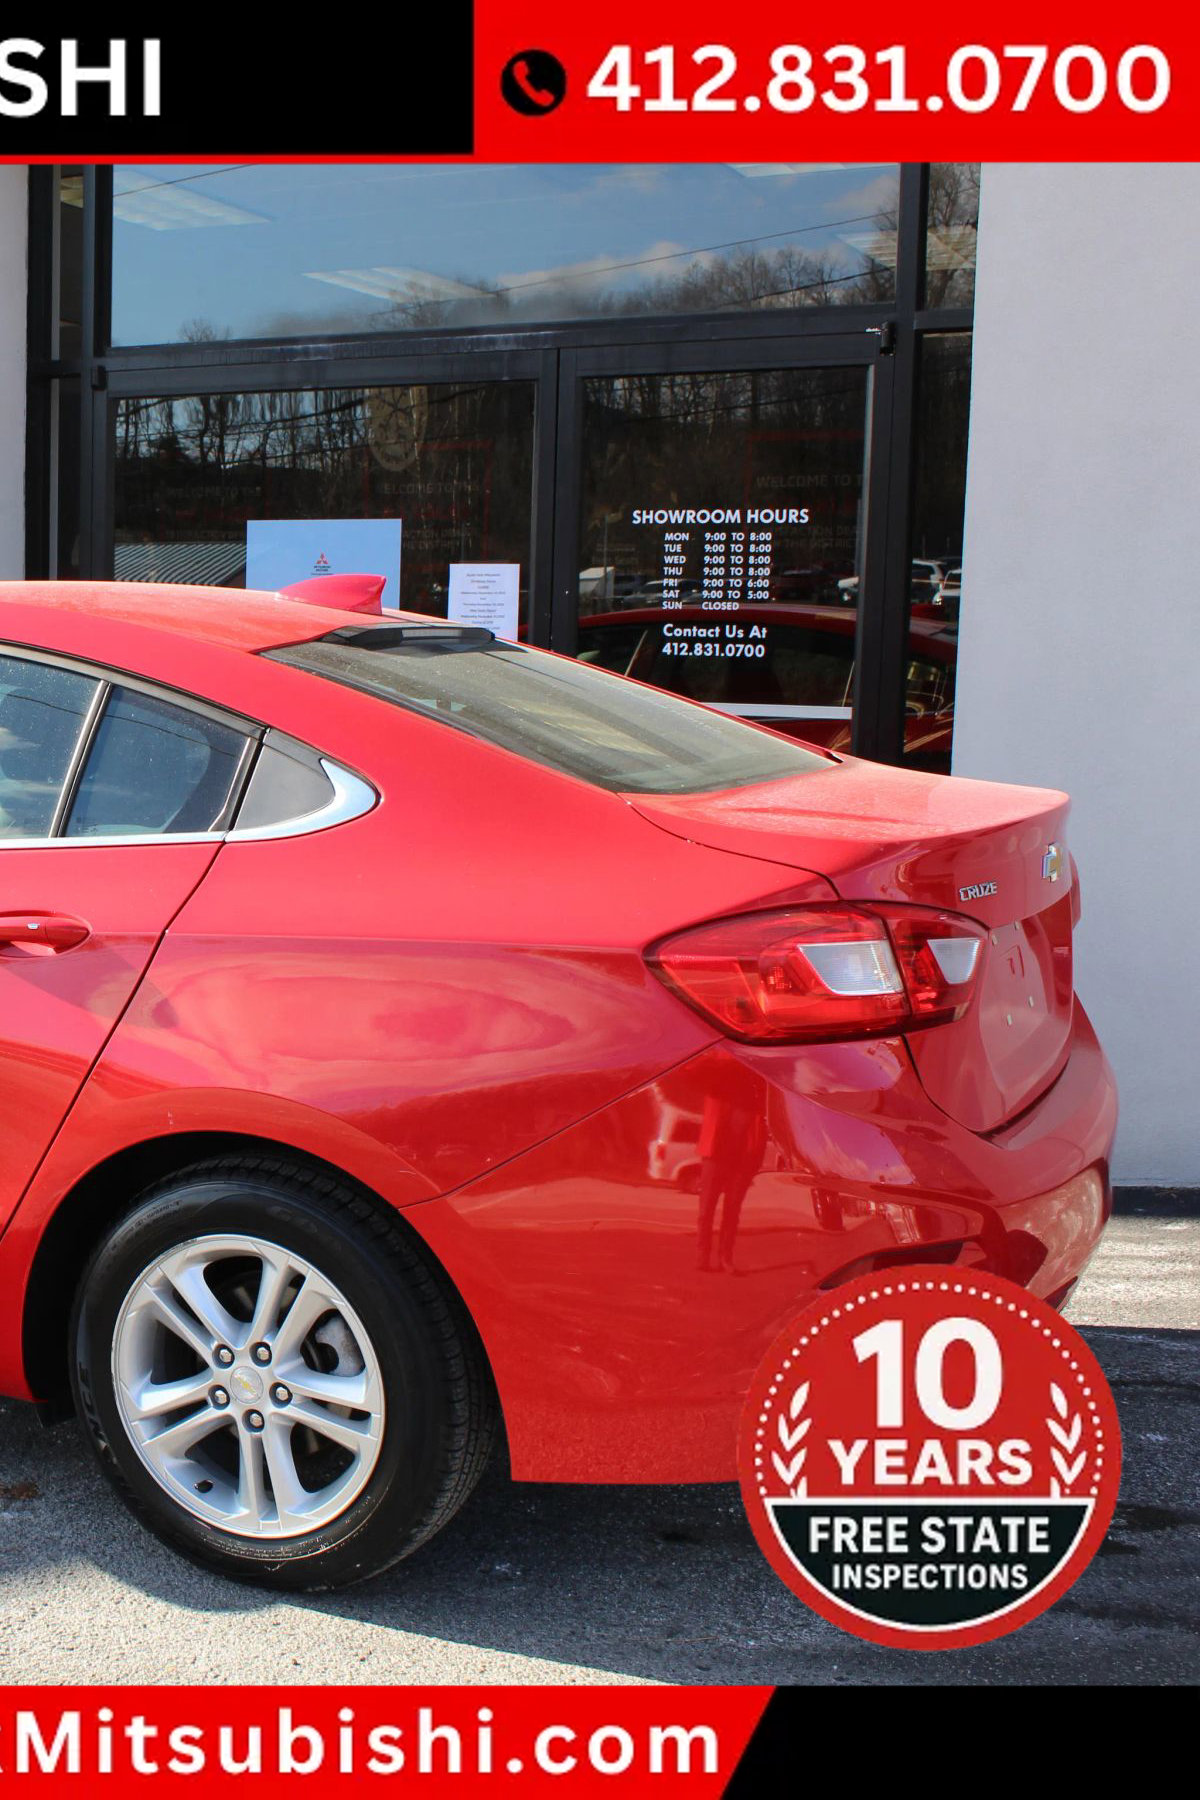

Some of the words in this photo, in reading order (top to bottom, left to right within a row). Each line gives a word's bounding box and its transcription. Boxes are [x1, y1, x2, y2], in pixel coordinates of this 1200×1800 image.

[632, 509, 741, 525] SHOWROOM
[746, 508, 809, 524] HOURS
[664, 532, 690, 541] MON
[704, 532, 727, 541] 9:00
[731, 532, 745, 541] TO
[749, 532, 772, 541] 8:00
[663, 544, 682, 553] TUE
[704, 544, 725, 553] 9:00
[730, 544, 744, 553] TO
[749, 544, 772, 553] 8:00
[663, 555, 687, 565] WED
[703, 555, 726, 565] 9:00
[730, 555, 744, 565] TO
[748, 555, 771, 565] 8:00
[663, 566, 683, 576] THU
[703, 566, 725, 576] 9:00
[730, 566, 744, 576] TO
[748, 566, 771, 576] 8:00
[663, 578, 678, 588] FRI
[702, 578, 724, 588] 9:00
[729, 578, 743, 588] TO
[747, 578, 770, 588] 6:00
[662, 589, 680, 599] SAT
[702, 589, 724, 599] 9:00
[727, 589, 741, 599] TO
[747, 589, 770, 600] 5:00
[662, 601, 683, 610] SUN
[701, 601, 740, 611] CLOSED
[663, 623, 721, 639] Contact
[725, 624, 744, 639] Us
[748, 625, 767, 639] At
[662, 642, 766, 658] 412.831.0700
[959, 881, 998, 902] CRUZE
